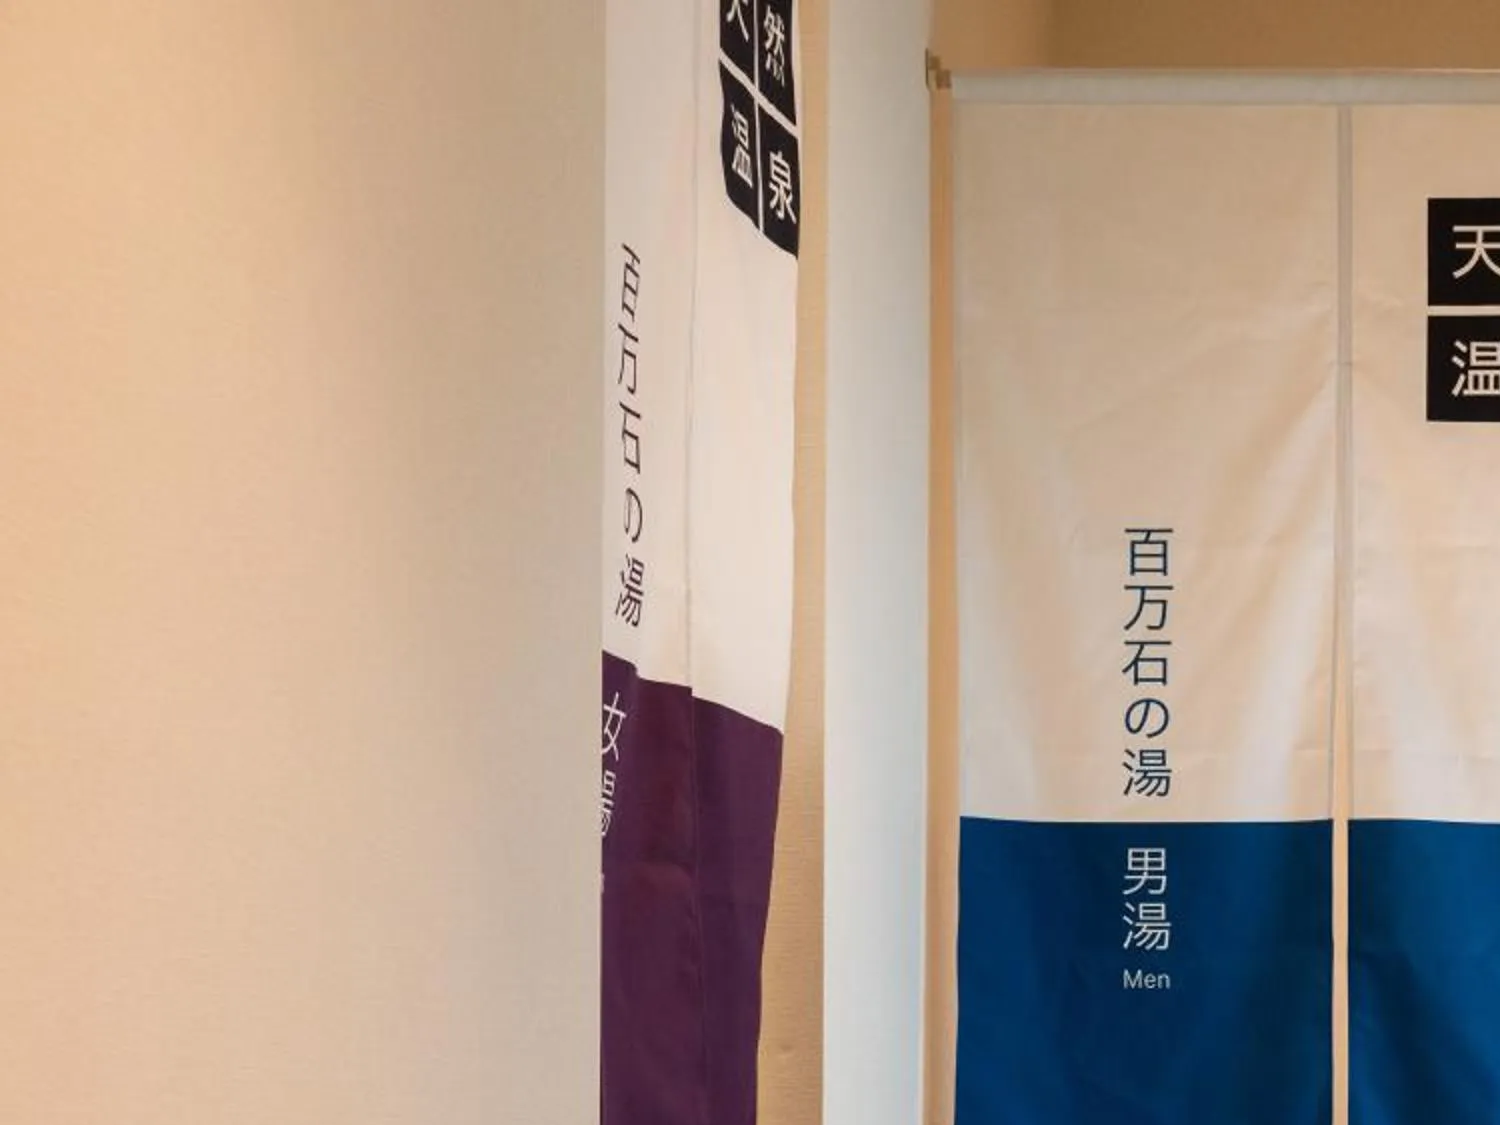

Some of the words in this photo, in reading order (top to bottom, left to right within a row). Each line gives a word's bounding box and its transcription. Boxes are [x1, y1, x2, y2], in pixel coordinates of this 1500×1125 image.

[730, 103, 797, 224] 温泉
[614, 243, 645, 628] 百万石の湯
[1121, 527, 1174, 797] 百万石の湯
[1121, 847, 1172, 952] 男湯
[1122, 967, 1171, 990] Men
